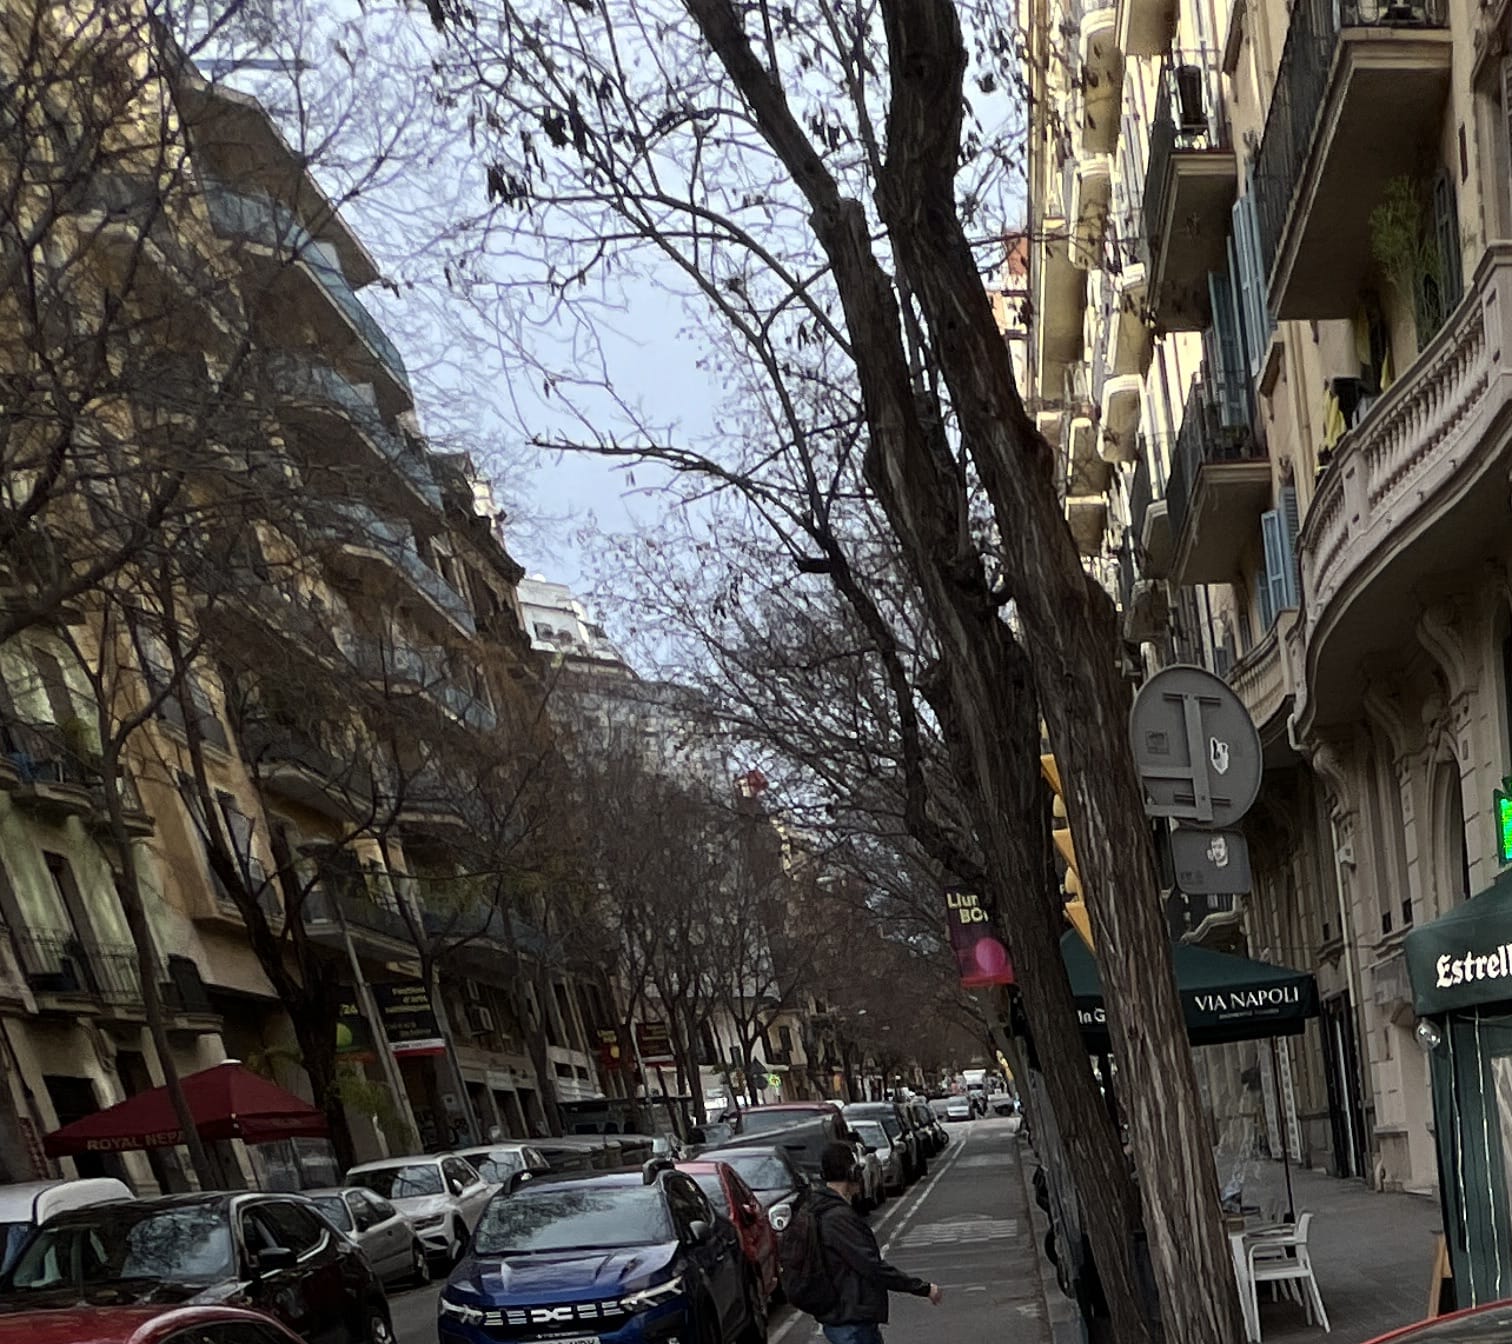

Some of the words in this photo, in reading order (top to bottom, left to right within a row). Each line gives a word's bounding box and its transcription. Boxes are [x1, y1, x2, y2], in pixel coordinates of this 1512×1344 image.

[1195, 994, 1227, 1011] VIA
[1230, 986, 1299, 1009] NAPOLI
[86, 1136, 143, 1150] ROYAL
